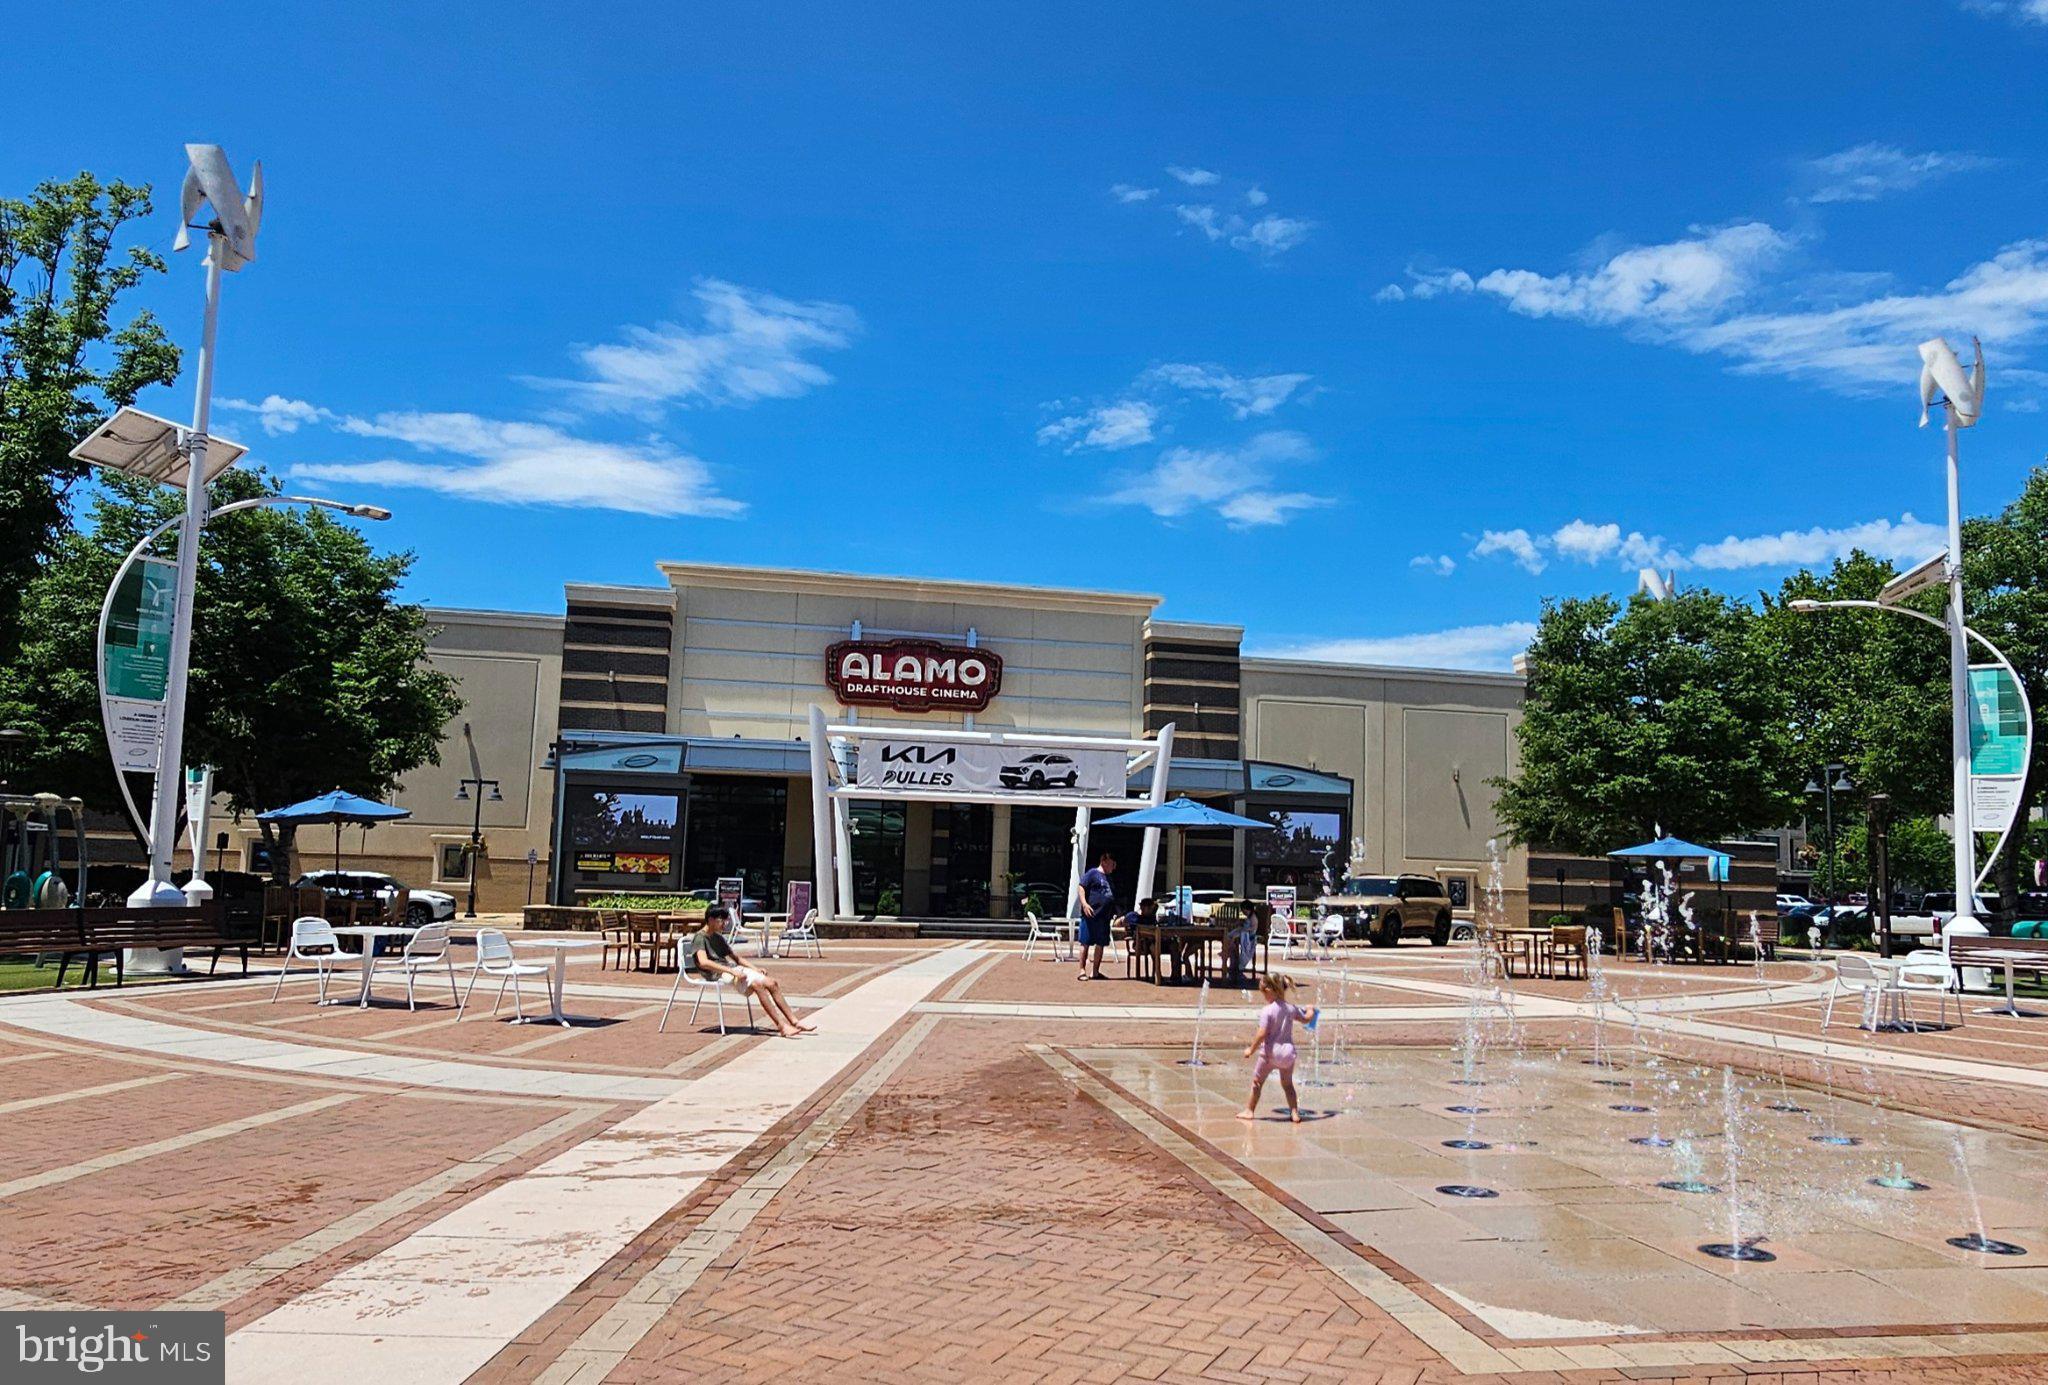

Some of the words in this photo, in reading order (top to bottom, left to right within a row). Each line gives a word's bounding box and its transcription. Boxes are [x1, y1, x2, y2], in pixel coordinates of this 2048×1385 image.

[842, 652, 986, 686] ALAMO
[847, 683, 927, 696] DRAFTHOUSE
[931, 688, 978, 699] CINEMA
[882, 745, 956, 765] KIA
